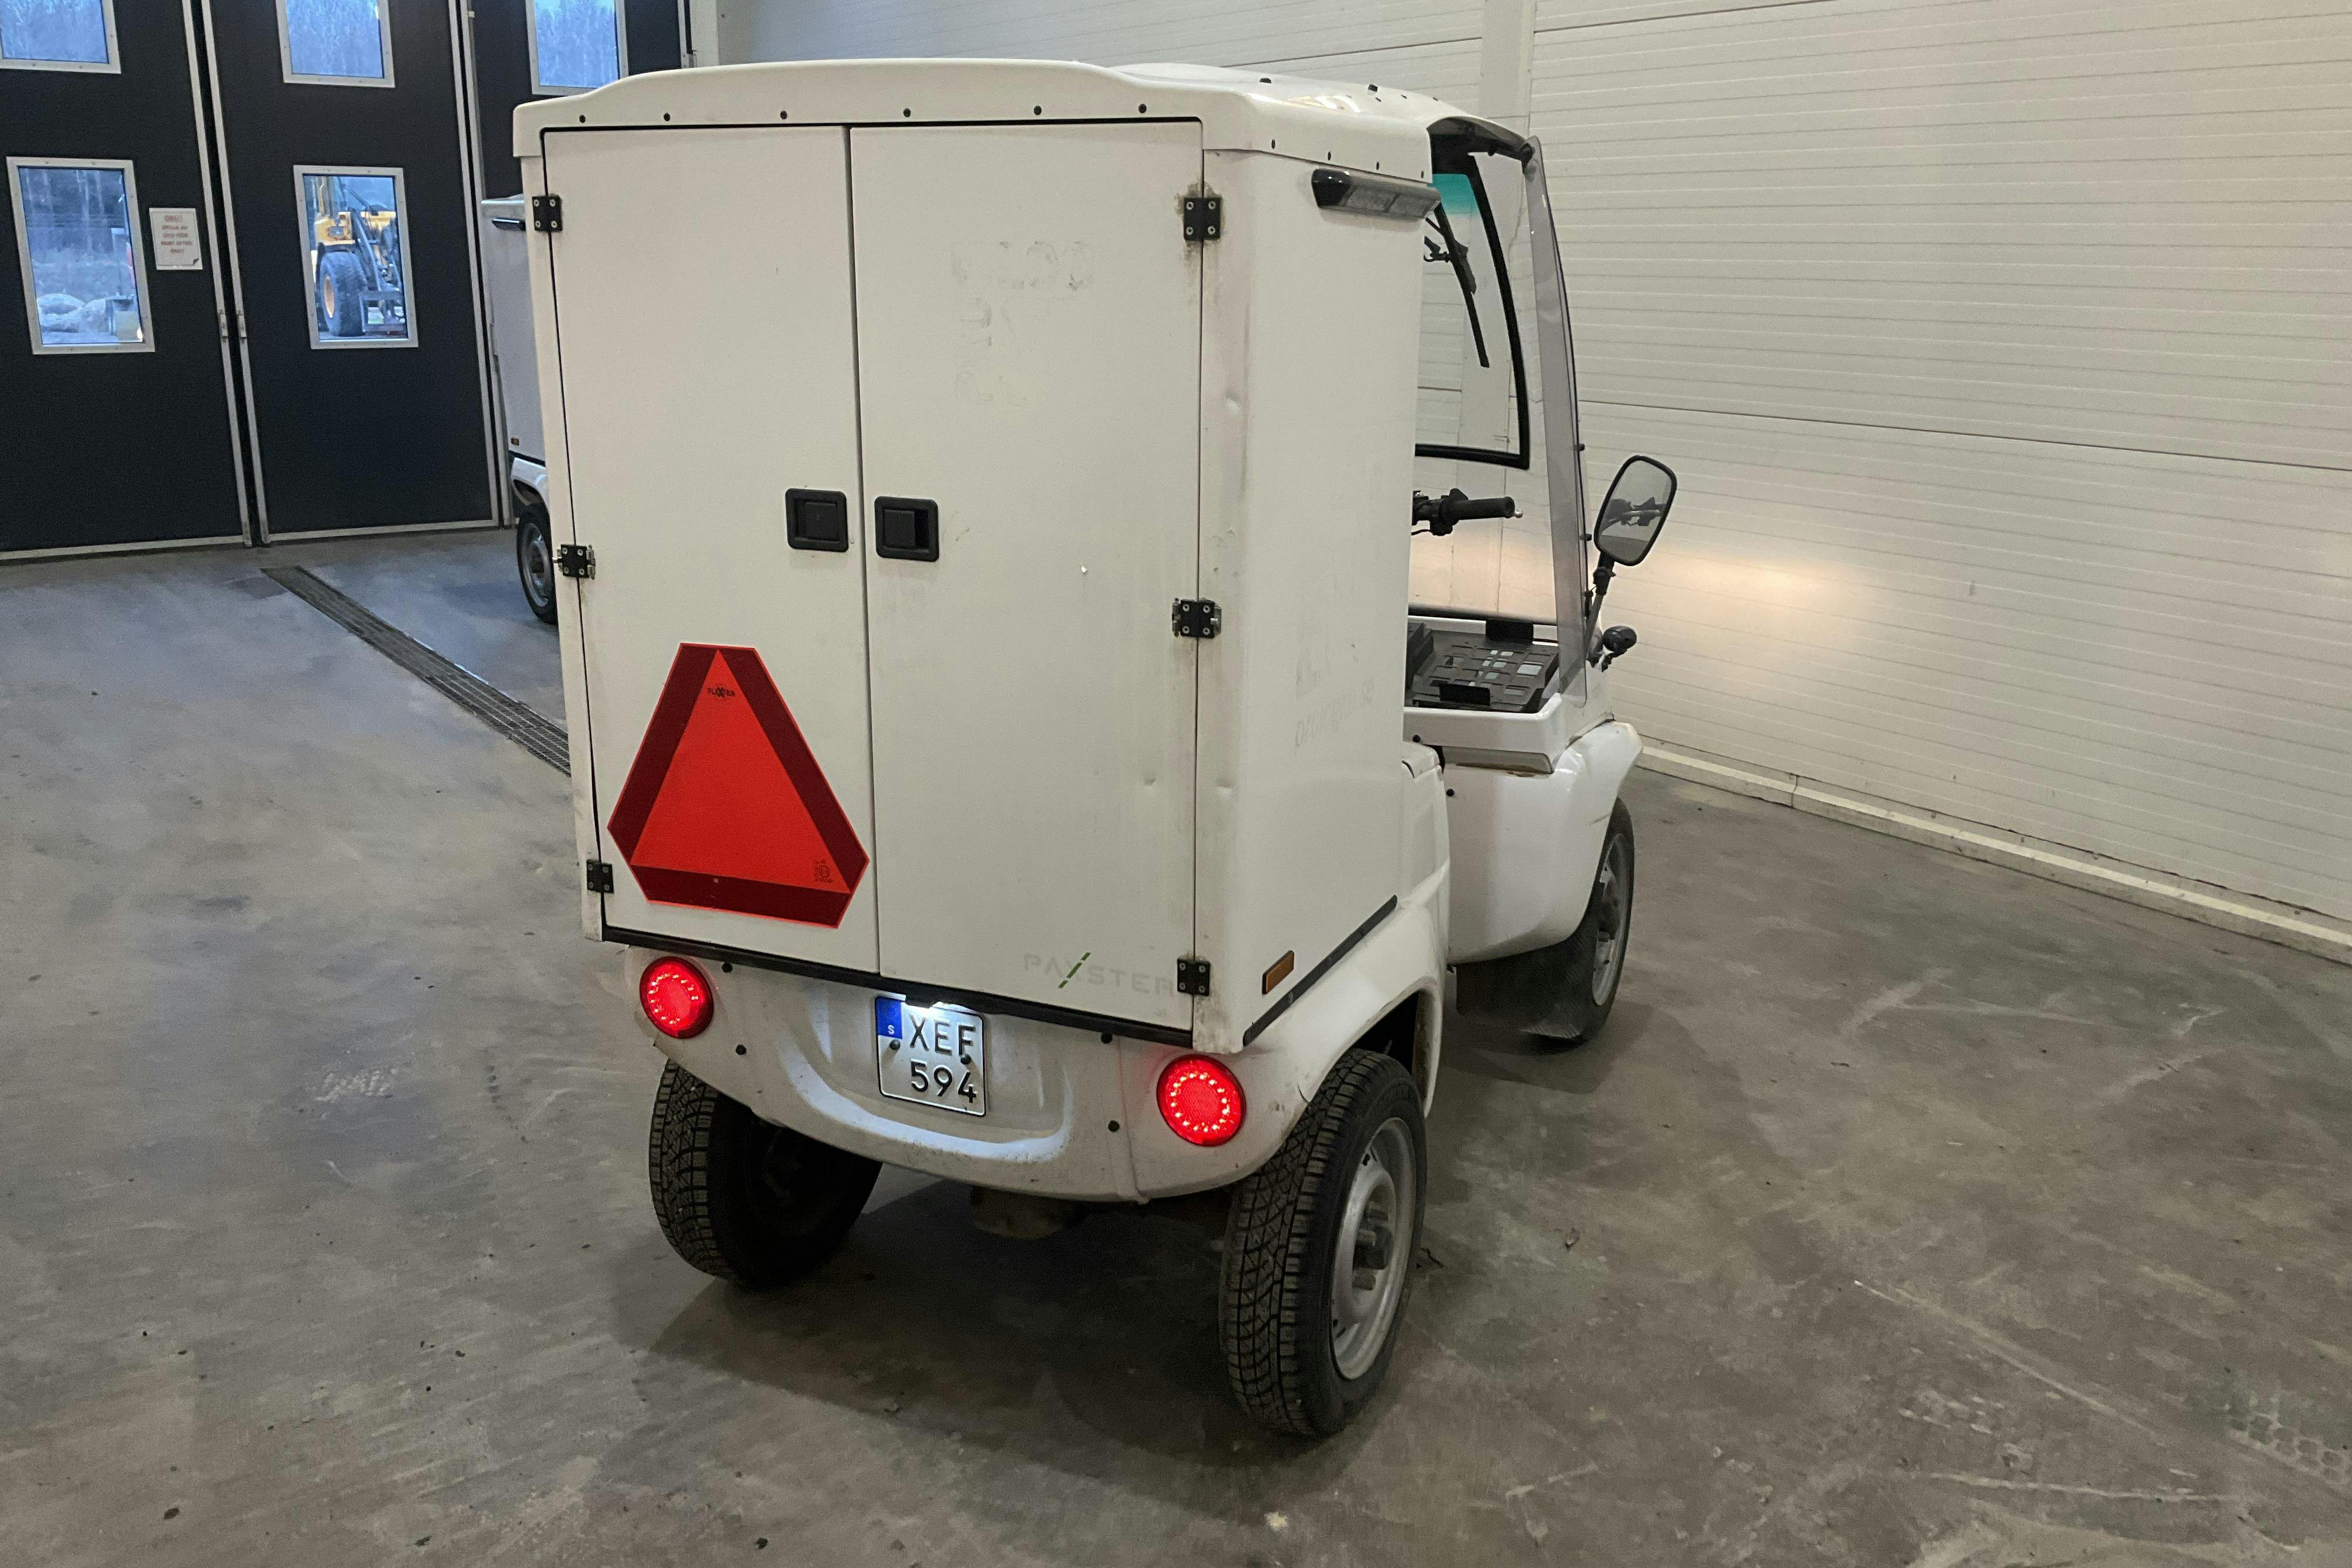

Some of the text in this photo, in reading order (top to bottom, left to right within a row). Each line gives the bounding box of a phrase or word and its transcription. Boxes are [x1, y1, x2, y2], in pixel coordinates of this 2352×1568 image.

[1023, 952, 1174, 998] PAXSTER
[888, 1024, 895, 1035] S
[909, 1014, 977, 1056] XEF
[910, 1058, 978, 1104] 594
